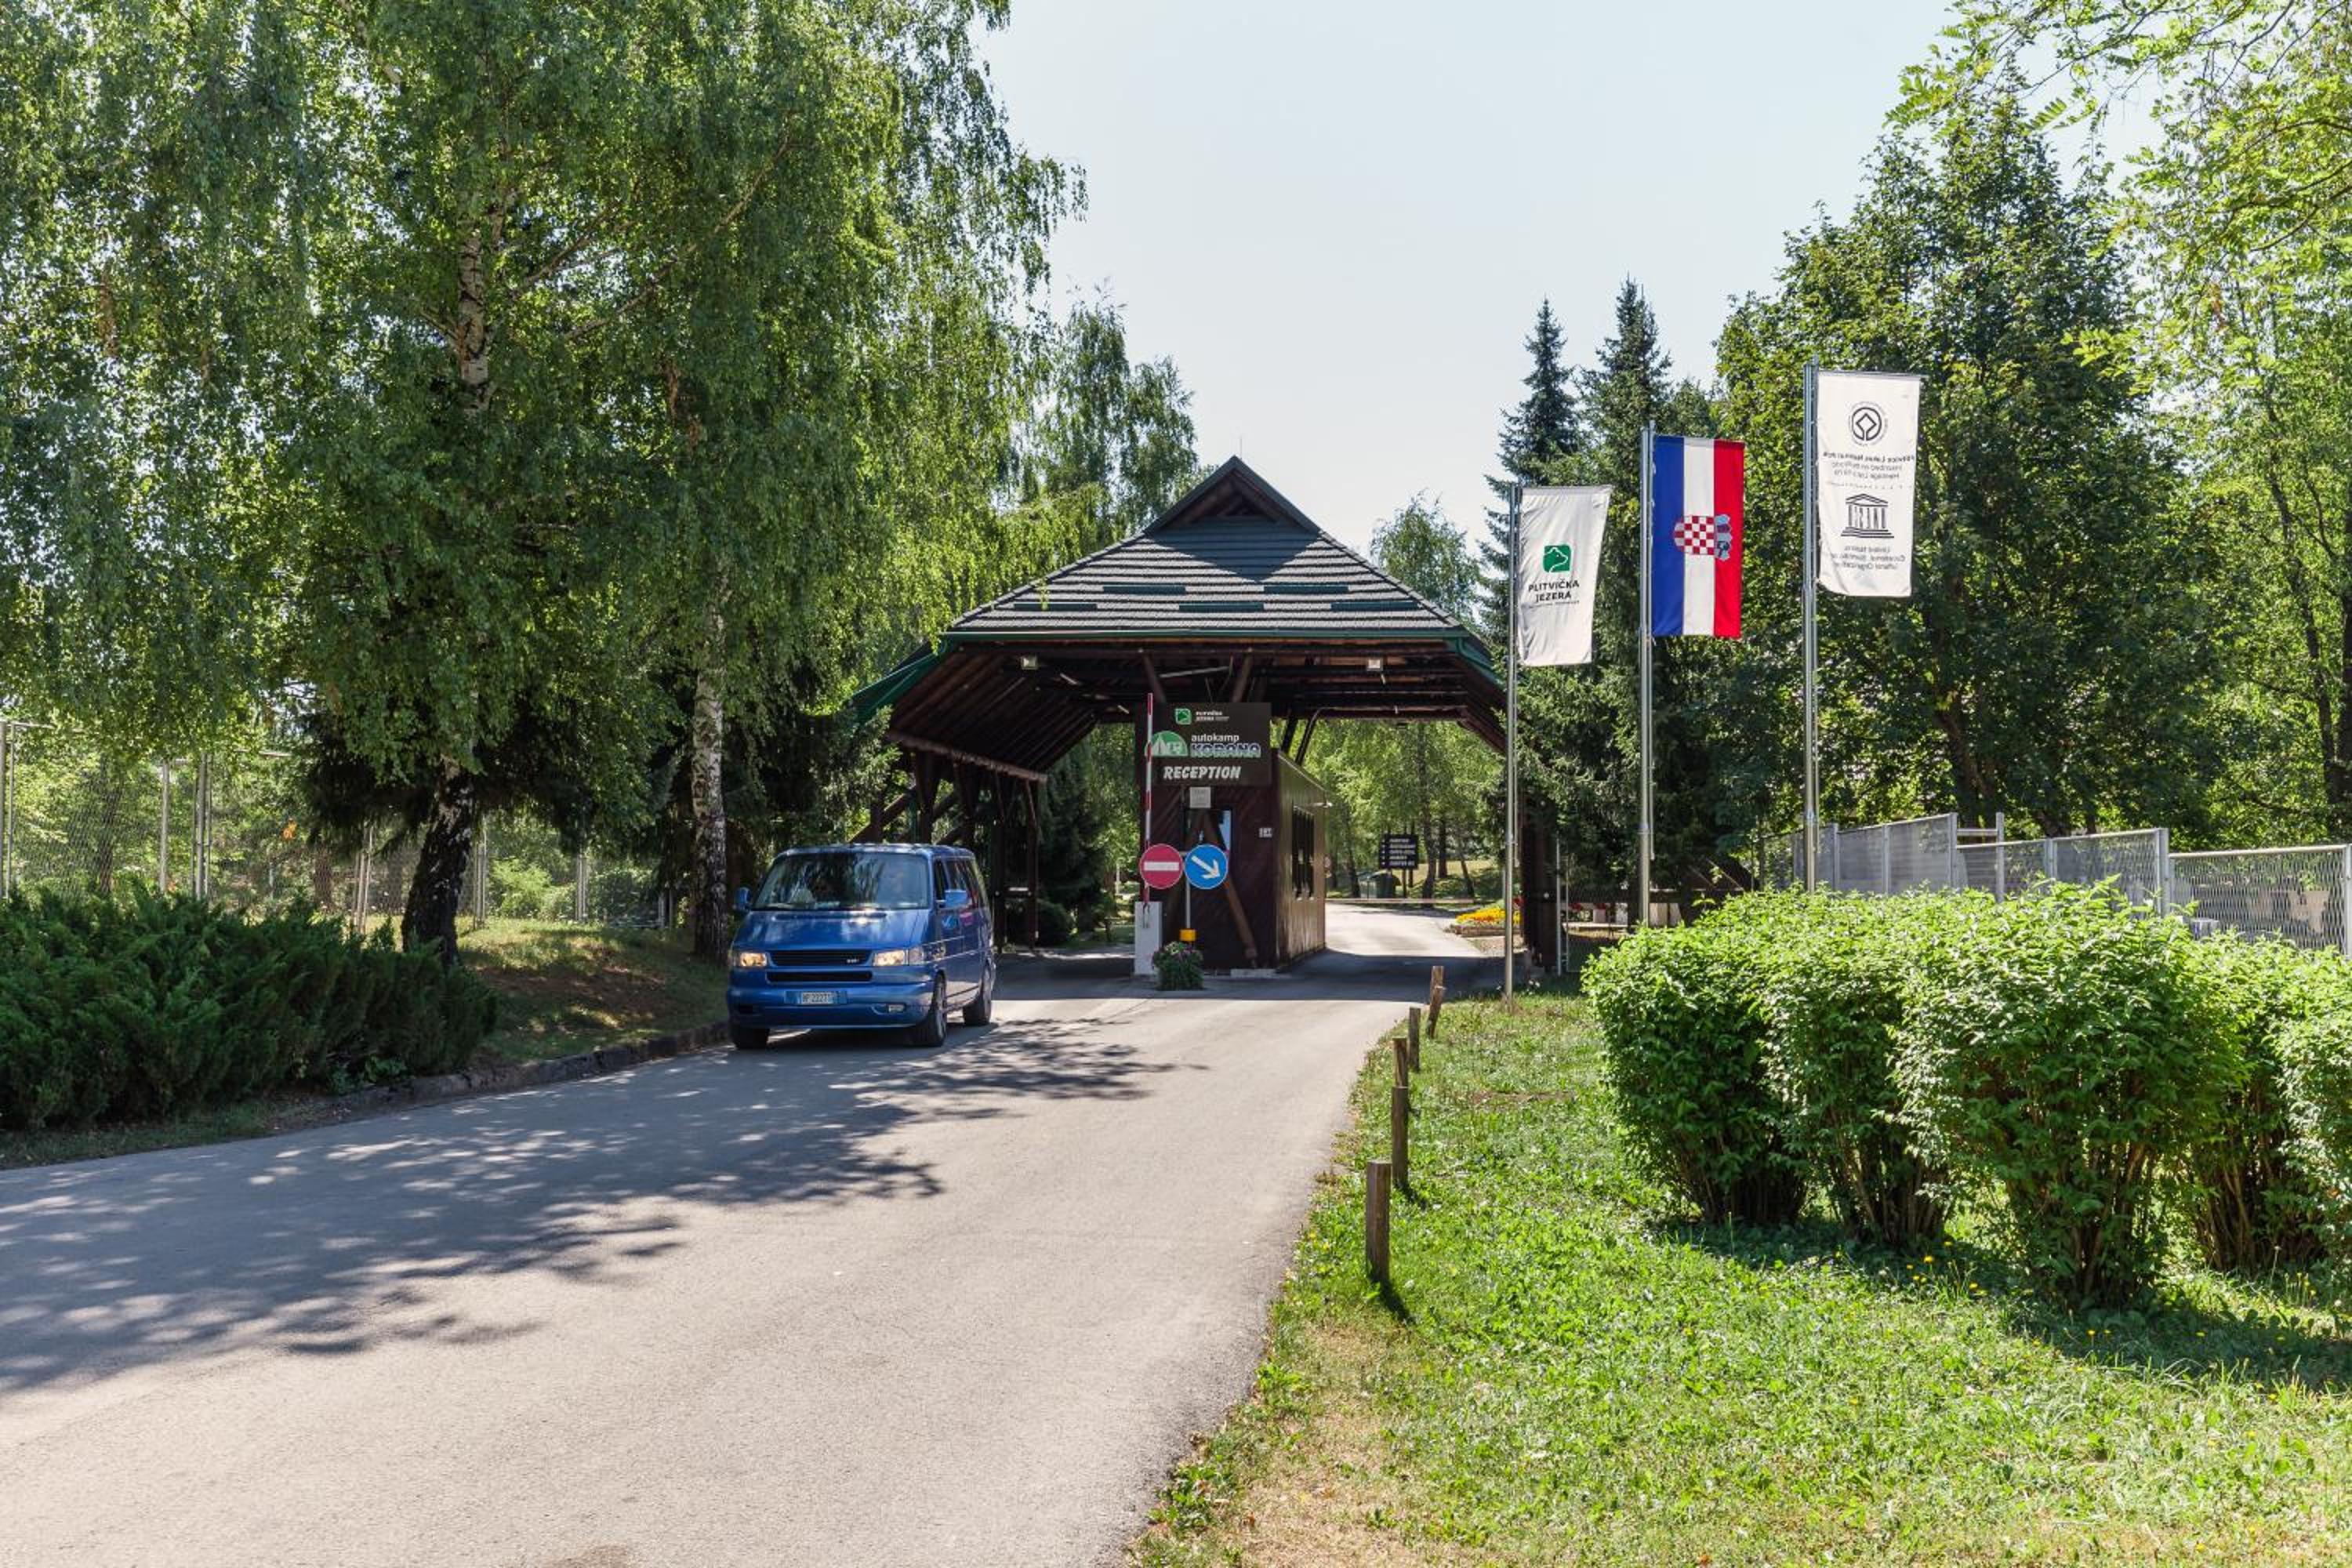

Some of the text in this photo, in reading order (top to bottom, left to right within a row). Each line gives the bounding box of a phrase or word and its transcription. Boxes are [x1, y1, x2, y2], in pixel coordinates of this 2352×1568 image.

[1528, 578, 1580, 592] PLITVIČKA
[1536, 591, 1572, 603] JEZERA
[1191, 733, 1240, 744] autokamp
[1190, 742, 1261, 758] KORANA
[1163, 766, 1242, 779] RECEPTION
